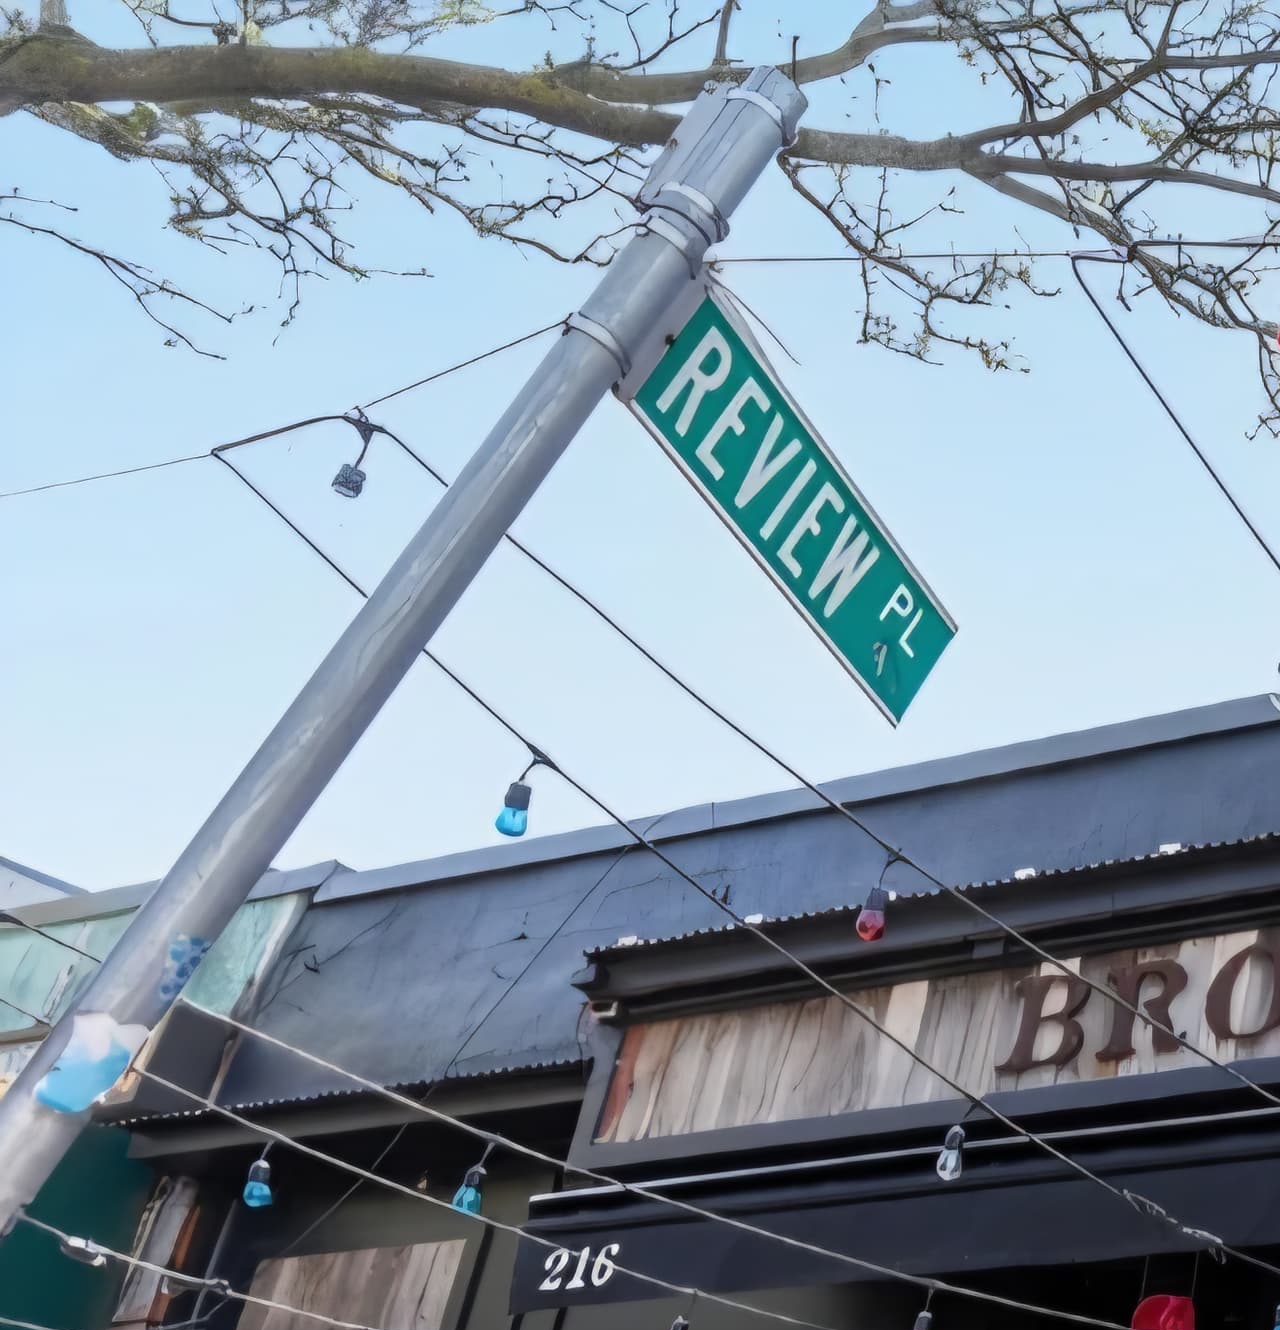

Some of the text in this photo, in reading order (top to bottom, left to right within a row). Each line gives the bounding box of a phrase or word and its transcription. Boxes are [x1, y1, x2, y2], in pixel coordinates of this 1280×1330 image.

[656, 325, 925, 658] REVIEW PL
[538, 1243, 619, 1290] 216
